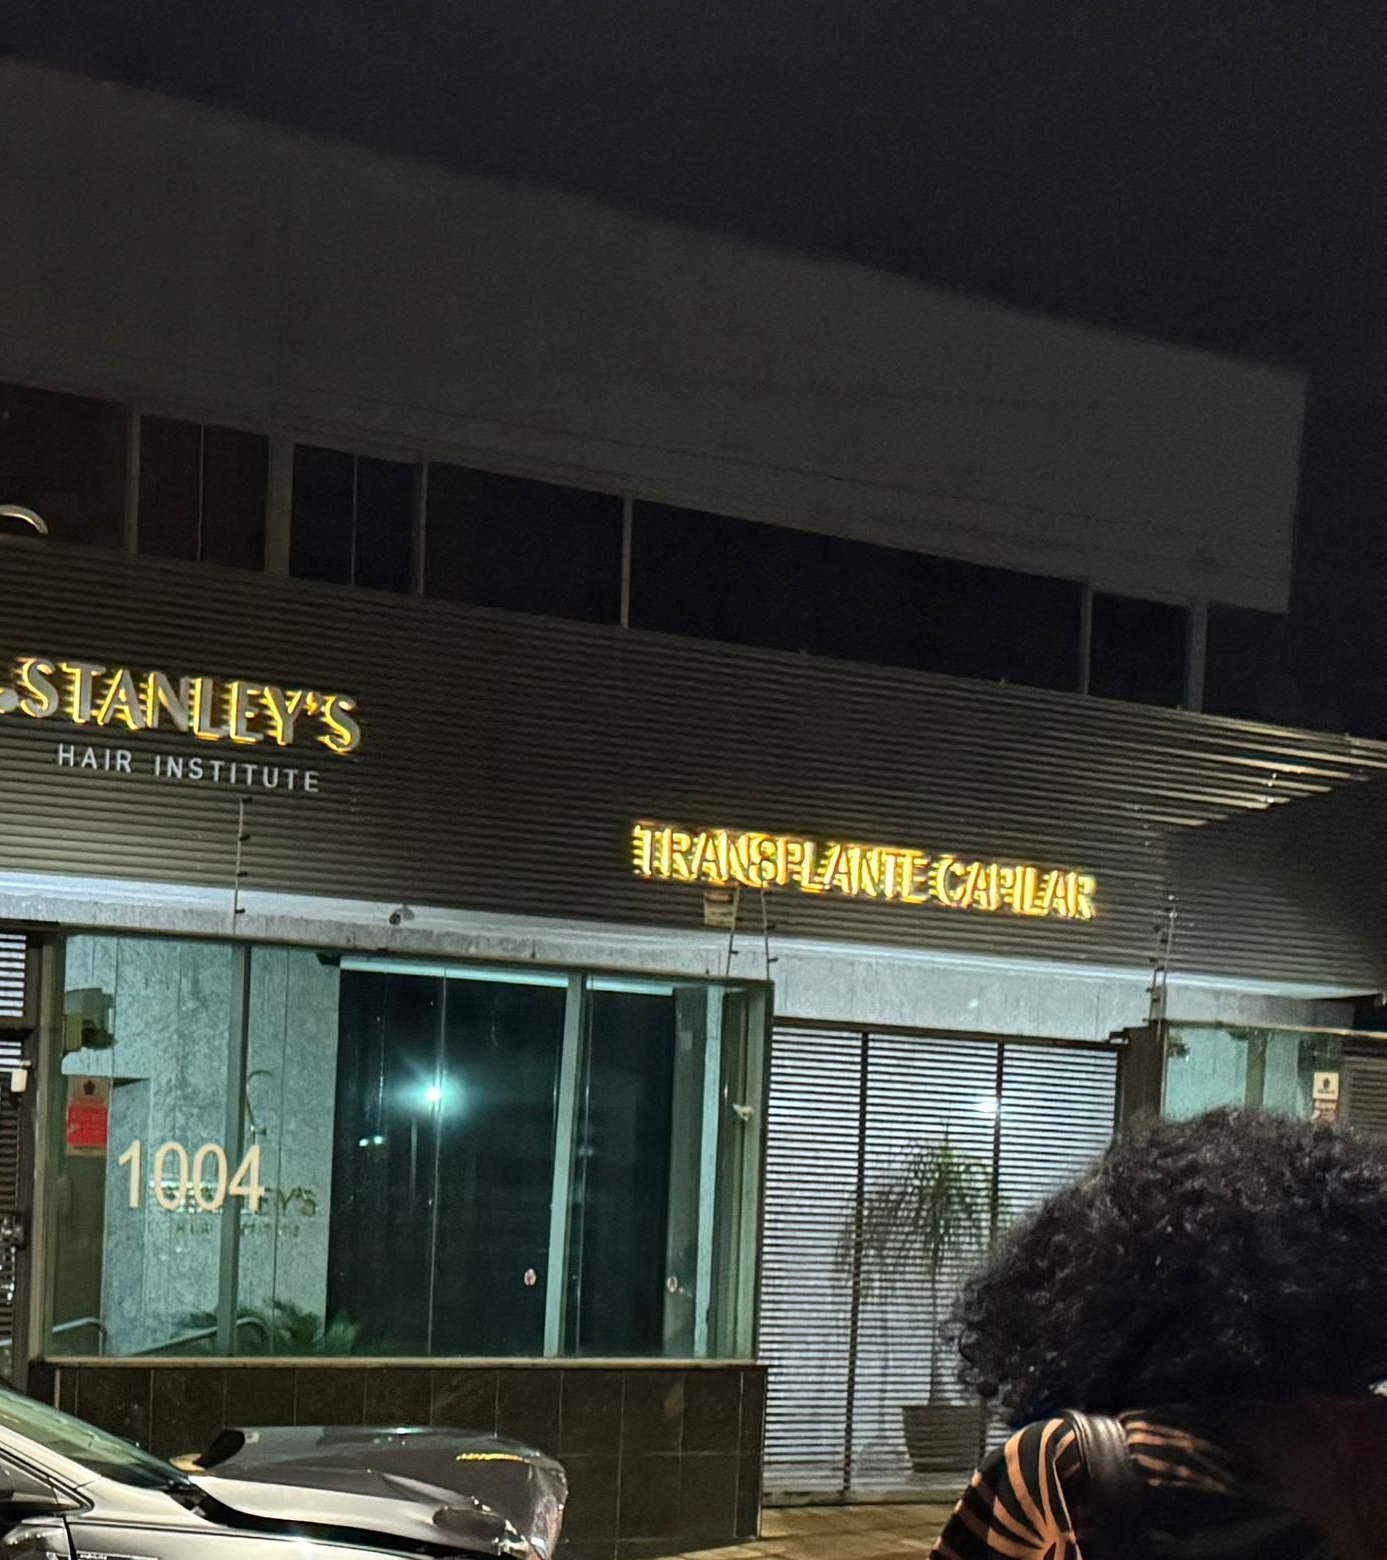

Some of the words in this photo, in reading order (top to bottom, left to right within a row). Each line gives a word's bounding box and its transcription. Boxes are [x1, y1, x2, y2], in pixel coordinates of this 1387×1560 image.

[18, 656, 363, 756] STANLEY'S
[57, 743, 133, 774] HAIR
[154, 754, 321, 794] INSTITUTE
[632, 823, 929, 904] TRANSPLANTE
[933, 856, 1099, 921] CAPILAR
[118, 1140, 266, 1213] 1004
